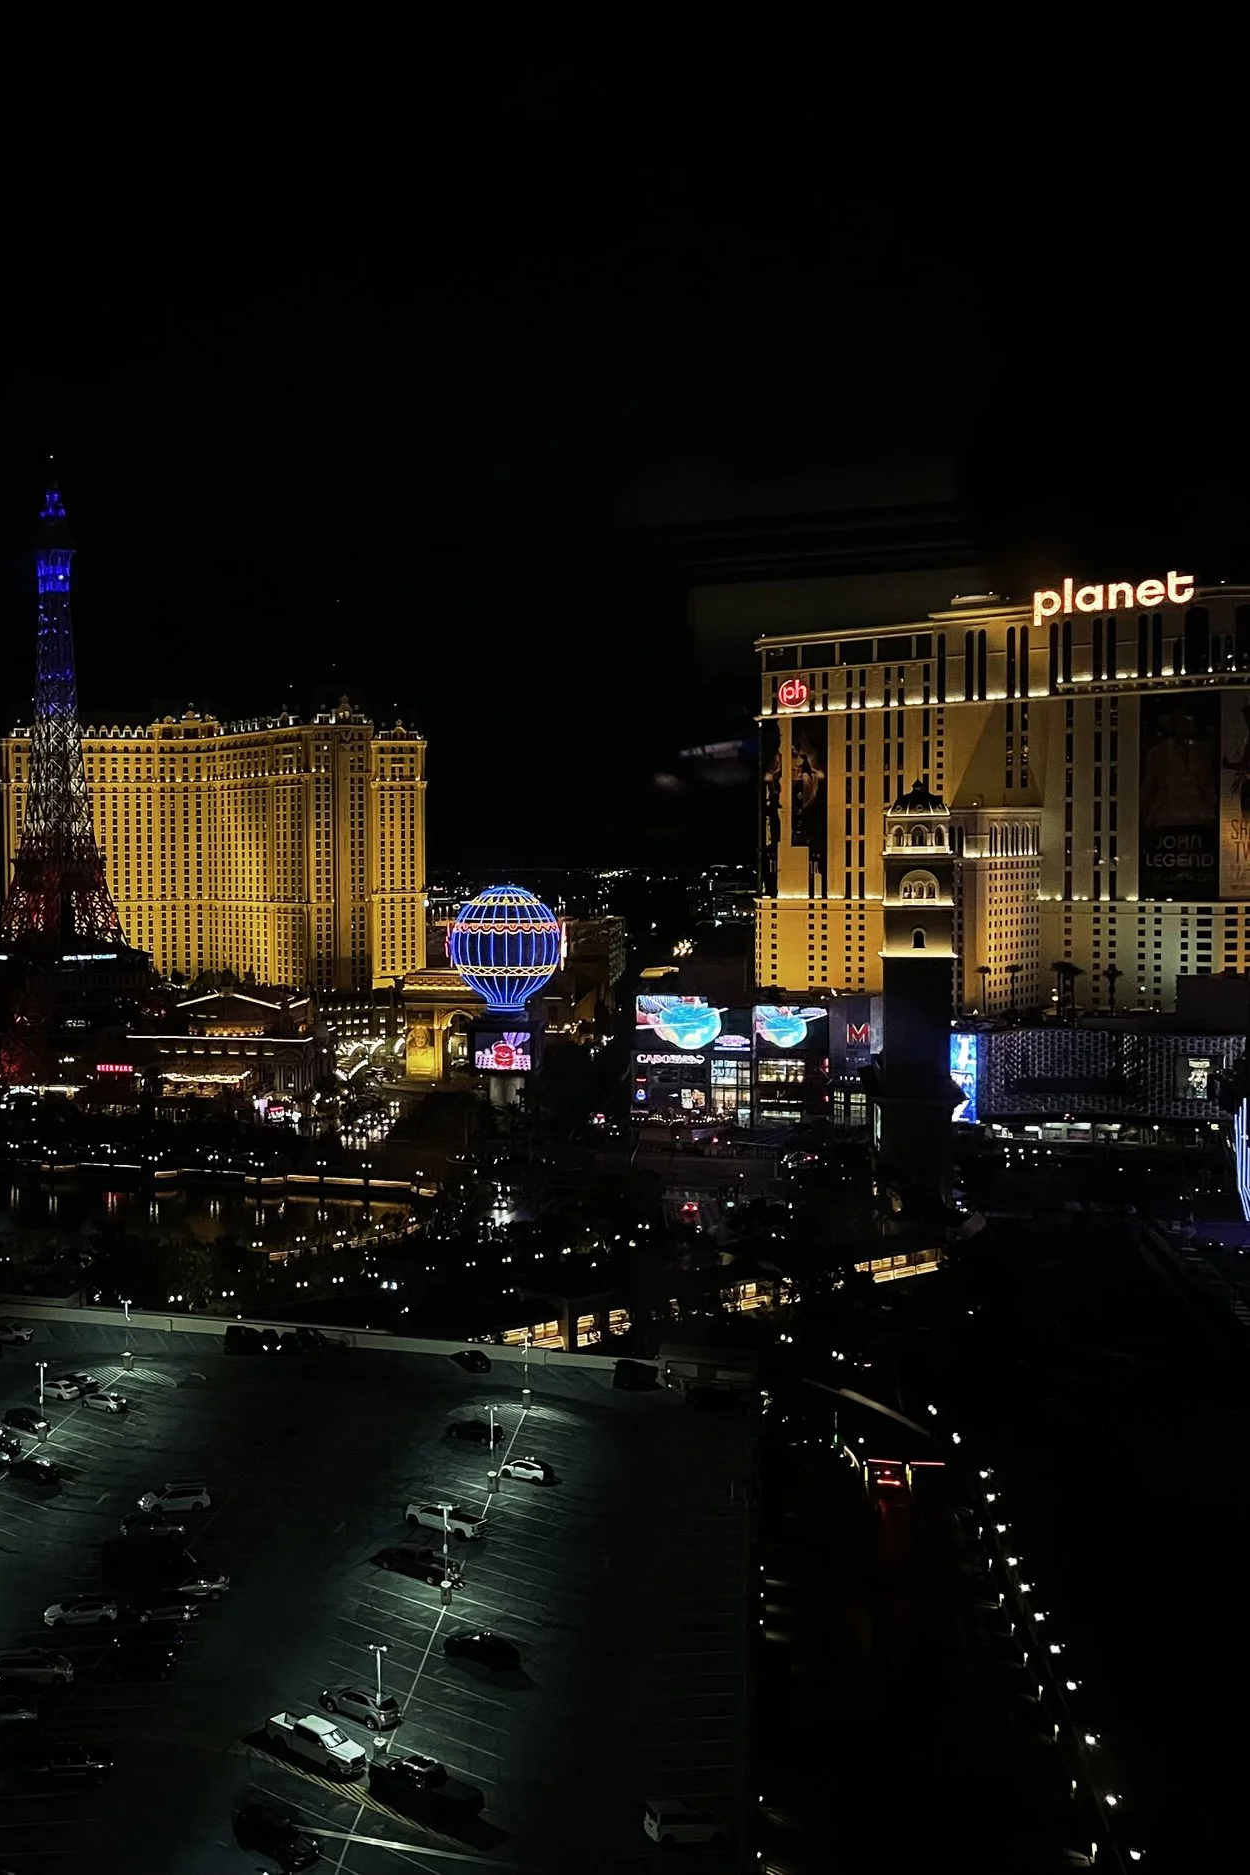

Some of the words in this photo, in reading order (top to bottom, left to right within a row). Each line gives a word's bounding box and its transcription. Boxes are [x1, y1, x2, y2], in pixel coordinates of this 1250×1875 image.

[1033, 570, 1195, 627] planet
[783, 679, 807, 702] ph
[1231, 819, 1250, 840] SH
[1155, 834, 1202, 850] JOHN
[1146, 853, 1215, 868] LEGEND
